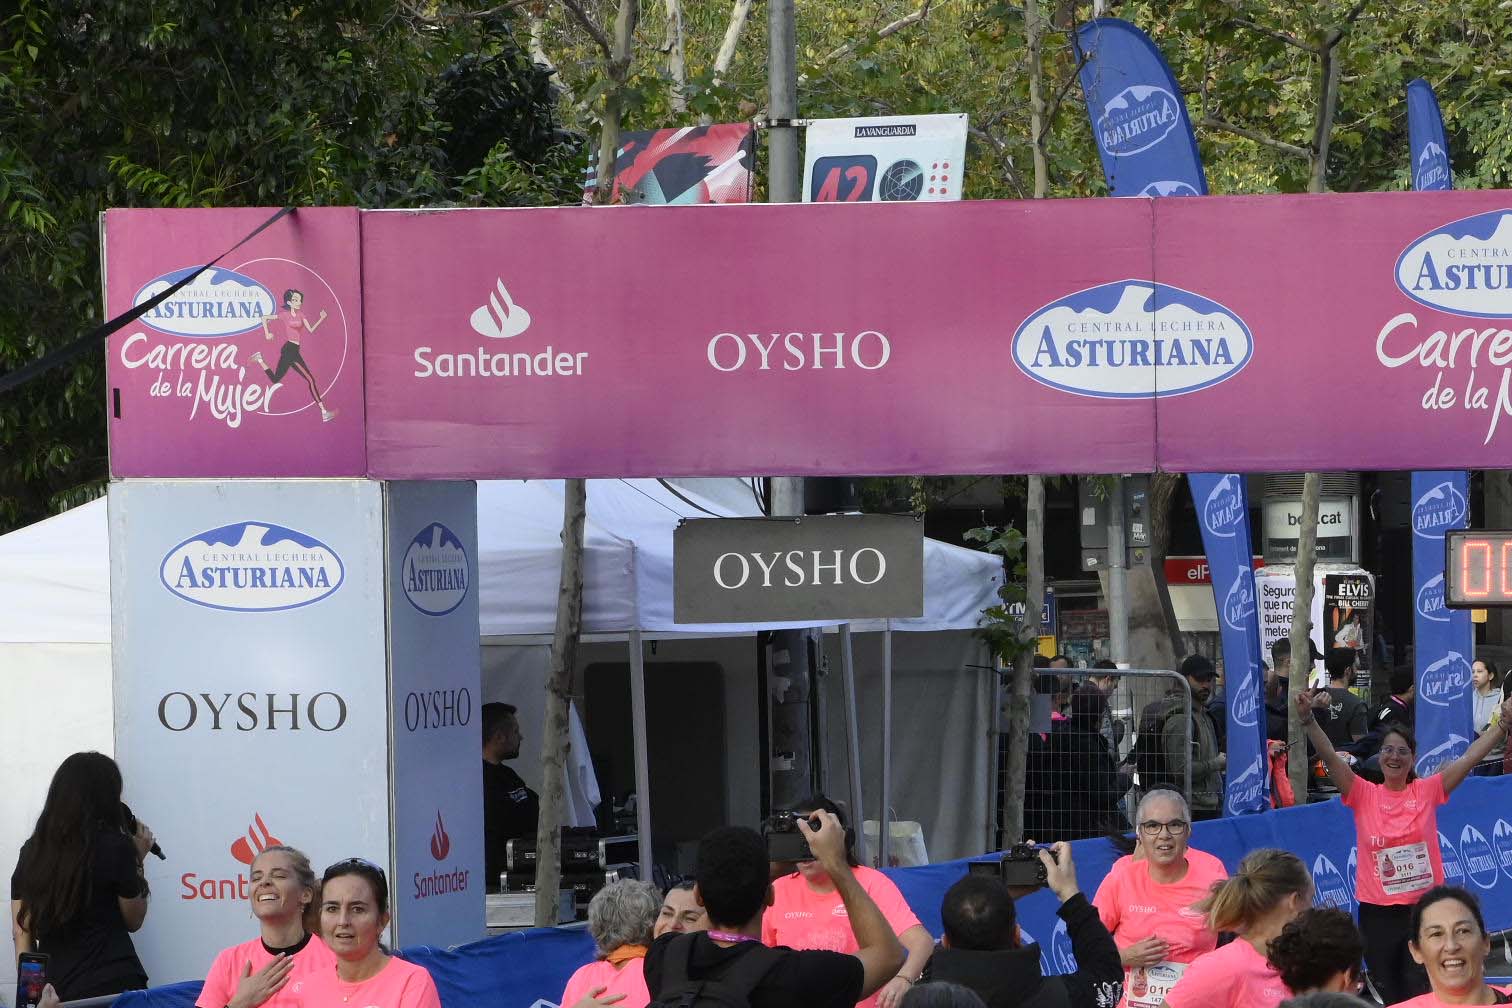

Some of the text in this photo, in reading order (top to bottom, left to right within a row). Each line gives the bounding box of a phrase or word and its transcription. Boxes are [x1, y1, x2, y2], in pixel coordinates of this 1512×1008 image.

[867, 125, 915, 137] VANGUARDIA
[1068, 320, 1226, 333] CENTRAL LECHERA
[120, 332, 238, 370] Carrera
[414, 345, 589, 378] Santander
[706, 330, 892, 374] OYSHO
[1031, 325, 1235, 368] ASTURIANA
[150, 366, 283, 428] de la Mujer
[1421, 373, 1457, 409] de
[1464, 370, 1488, 409] la
[175, 555, 332, 590] ASTURIANA
[202, 552, 325, 562] CENTRAL LECHERA
[407, 554, 466, 593] ASTURIANA
[713, 547, 887, 590] OYSHO
[1338, 584, 1369, 596] ELVIS
[1264, 602, 1279, 613] que
[1264, 614, 1294, 628] quiere
[158, 691, 348, 732] OYSHO
[405, 687, 471, 732] OYSHO
[1370, 835, 1385, 848] TU
[414, 869, 470, 900] Santander
[1396, 863, 1414, 872] 016
